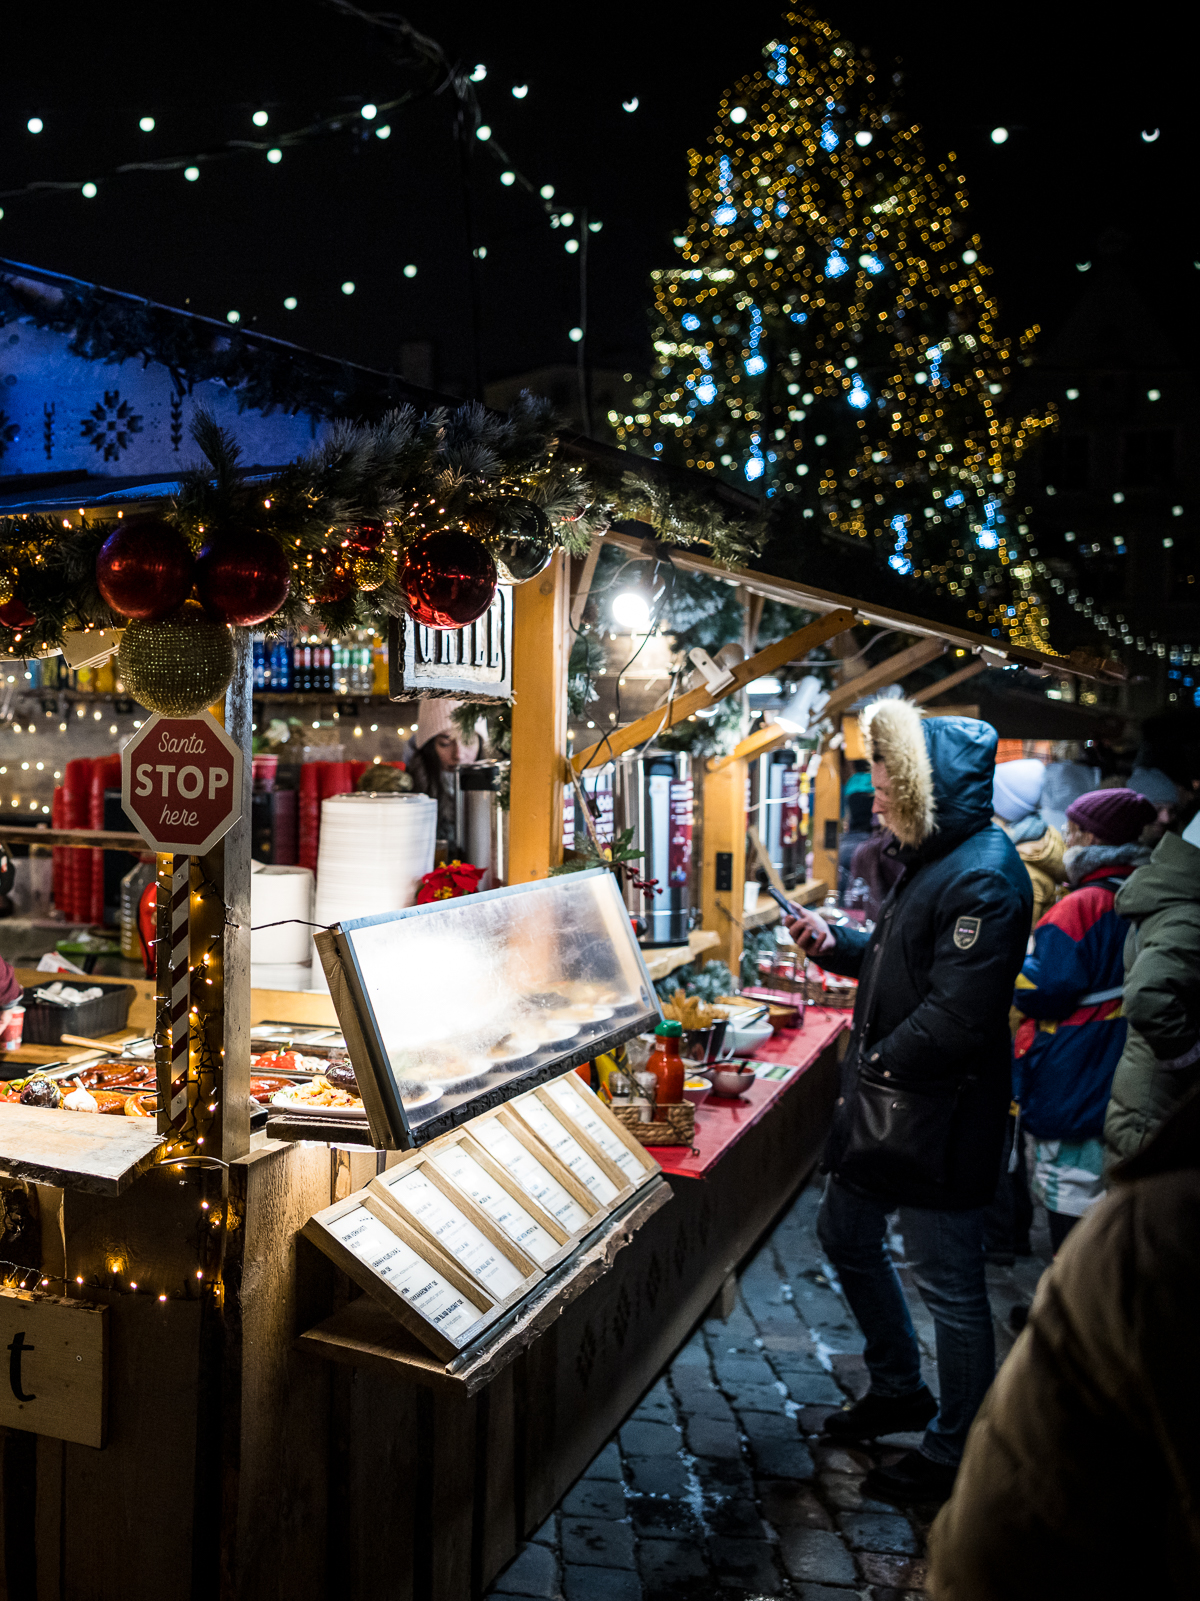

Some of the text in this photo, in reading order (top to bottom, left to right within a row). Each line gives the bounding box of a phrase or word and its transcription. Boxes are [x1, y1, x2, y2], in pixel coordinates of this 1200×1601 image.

[158, 731, 207, 754] Santa
[134, 763, 229, 800] STOP
[158, 804, 200, 827] here
